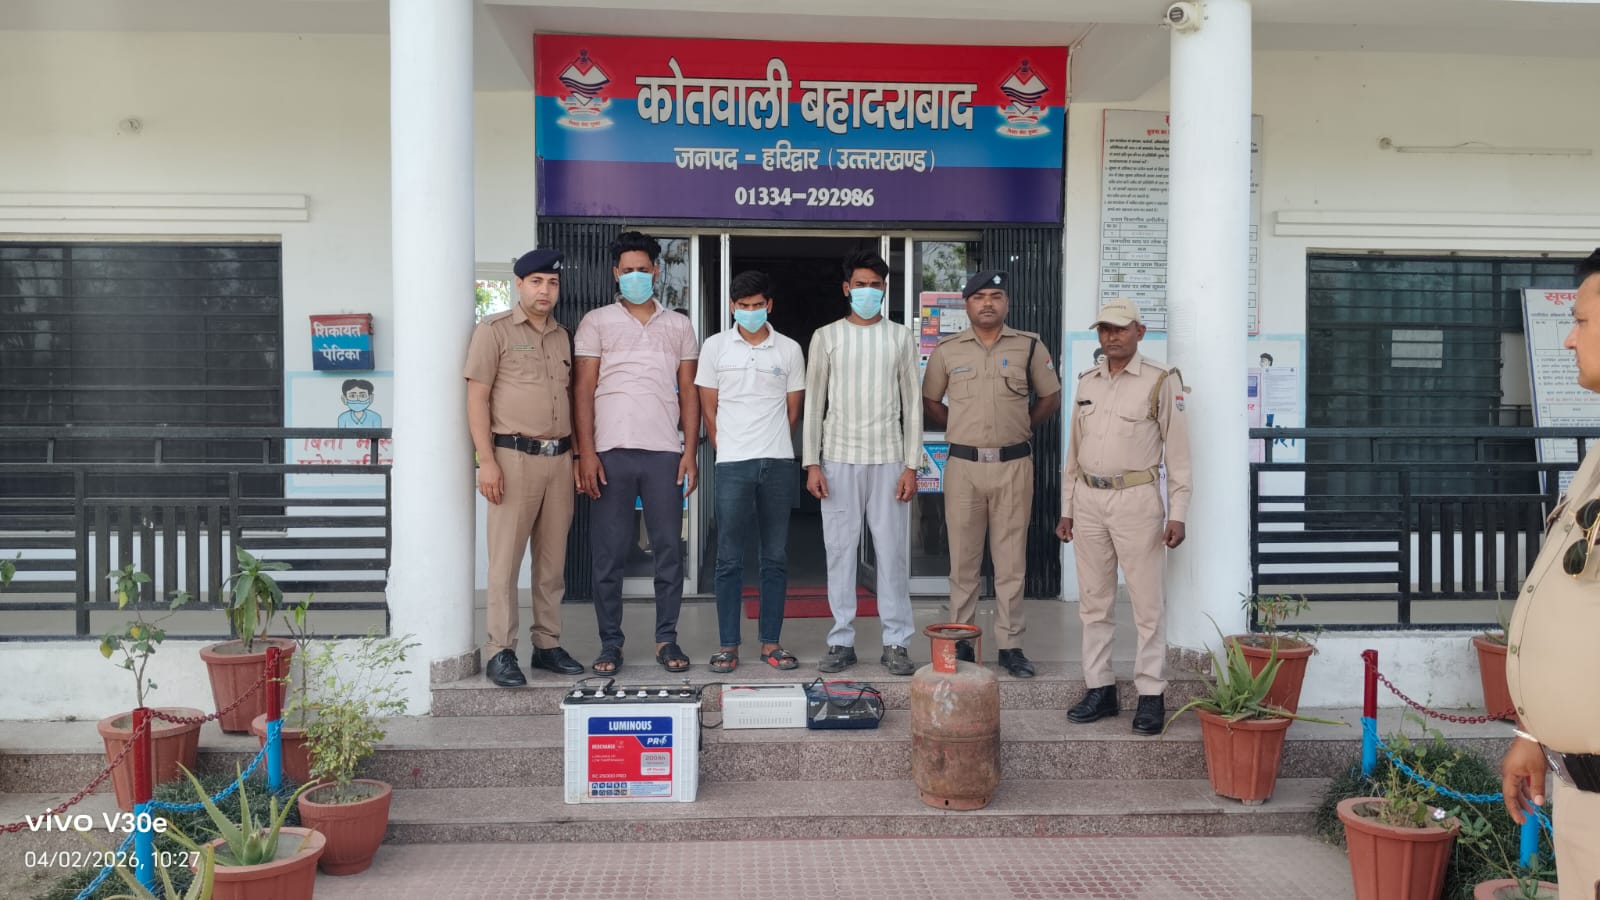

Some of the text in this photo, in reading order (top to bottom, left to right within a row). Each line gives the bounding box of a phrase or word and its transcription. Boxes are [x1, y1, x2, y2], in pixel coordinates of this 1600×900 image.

[635, 56, 977, 134] कोतवाली बहादराबाद
[674, 146, 738, 171] जनपद
[761, 140, 821, 173] हरिद्वार
[734, 188, 875, 208] 01334-292986
[314, 322, 361, 338] शिकायत
[609, 720, 652, 731] LUMINOUS
